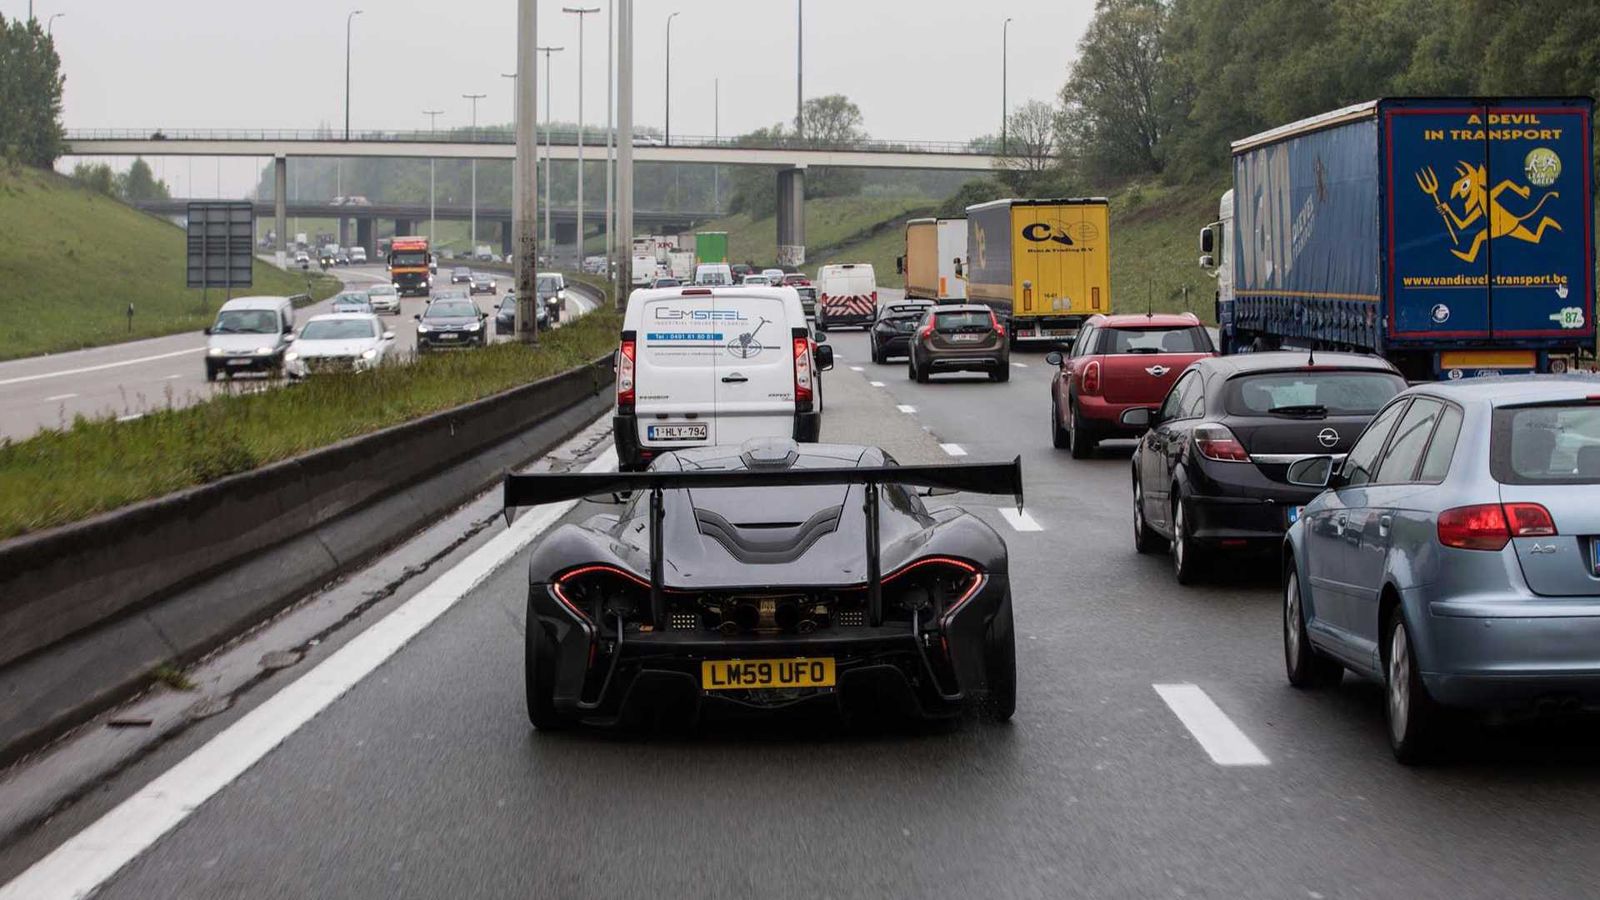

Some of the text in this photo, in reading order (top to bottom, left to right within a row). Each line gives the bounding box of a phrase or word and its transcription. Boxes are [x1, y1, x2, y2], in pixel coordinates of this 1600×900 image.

[1467, 114, 1540, 125] A DEVIL
[1424, 129, 1562, 140] IN TRANSPORT
[655, 306, 748, 320] CEMSTEEL
[1565, 312, 1578, 324] 87
[655, 427, 705, 437] 1-HLY-794
[1531, 543, 1556, 554] A3
[711, 662, 824, 685] LM59 UFO
